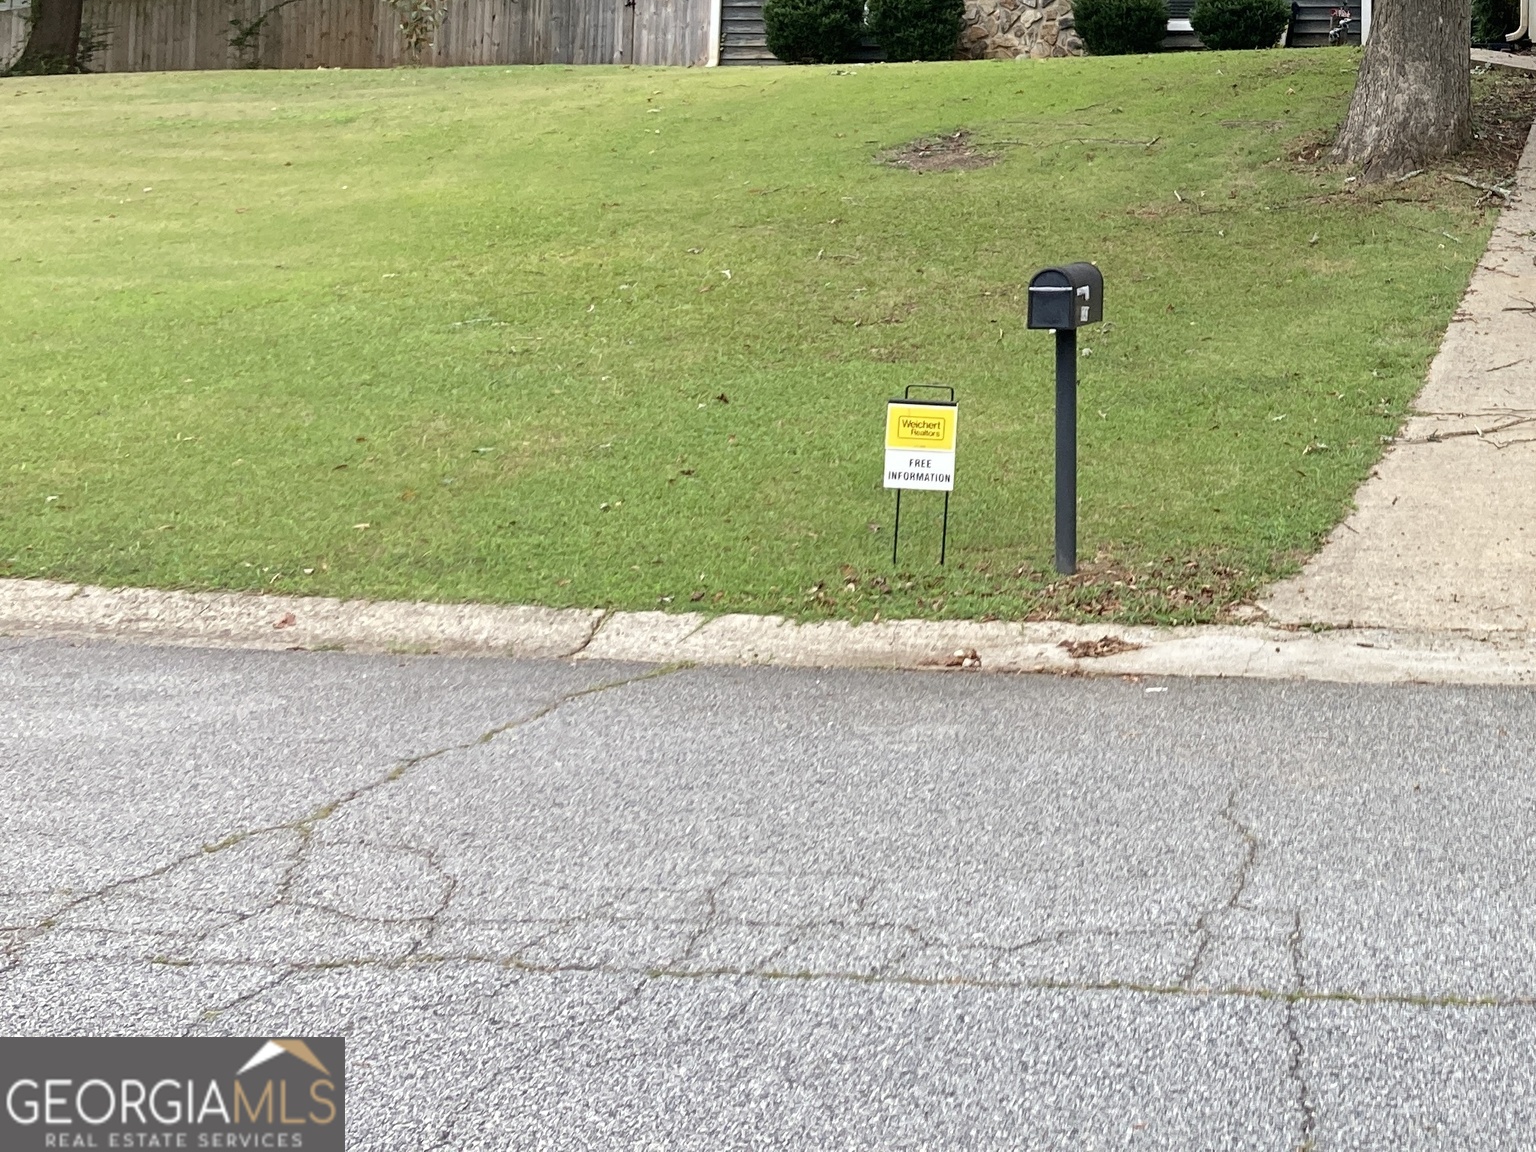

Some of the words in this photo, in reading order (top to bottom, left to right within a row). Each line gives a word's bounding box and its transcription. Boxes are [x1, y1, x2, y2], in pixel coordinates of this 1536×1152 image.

[902, 419, 941, 429] Weichert
[911, 429, 940, 437] Realtors
[909, 458, 932, 468] FREE
[888, 471, 951, 483] INFORMATION
